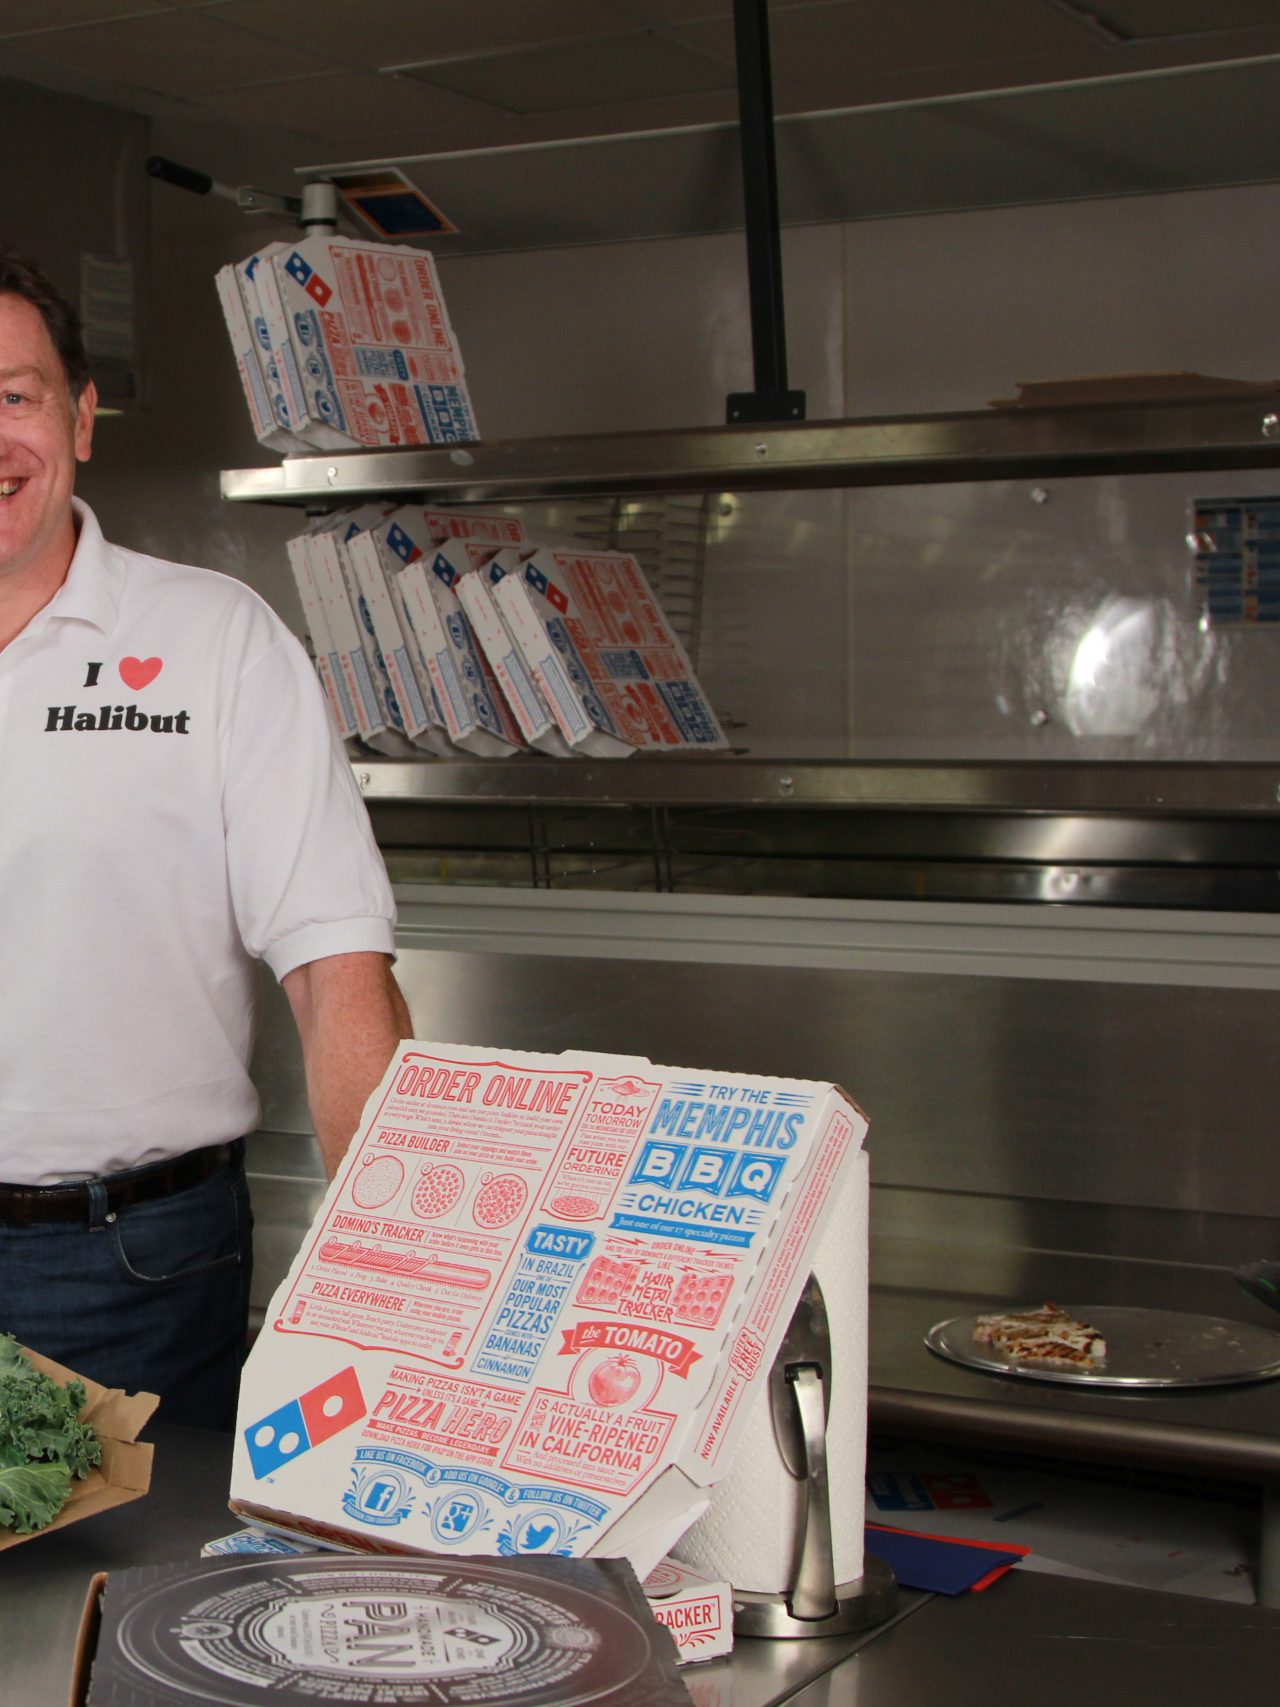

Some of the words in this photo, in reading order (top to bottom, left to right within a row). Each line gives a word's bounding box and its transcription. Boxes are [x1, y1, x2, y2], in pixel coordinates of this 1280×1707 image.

[83, 662, 103, 687] I
[44, 704, 190, 734] Halibut
[397, 1065, 482, 1103] ORDER
[482, 1075, 579, 1114] ONLINE
[709, 1084, 739, 1102] TRY
[740, 1087, 772, 1104] THE
[586, 1113, 642, 1128] TOMORROW
[592, 1101, 647, 1117] TODAY
[649, 1098, 805, 1150] MEMPHIS
[378, 1131, 407, 1147] PIZZA
[407, 1135, 450, 1153] BUILDER
[564, 1162, 620, 1176] ORDERING
[568, 1148, 626, 1167] FUTURE
[641, 1148, 773, 1191] BBQ
[637, 1194, 746, 1224] CHICKEN
[332, 1215, 379, 1235] DOMINO'S
[616, 1217, 633, 1227] Just
[634, 1221, 647, 1229] one
[648, 1221, 658, 1230] of
[674, 1226, 682, 1235] 17
[683, 1225, 719, 1241] specialty
[719, 1233, 745, 1243] pizzas
[533, 1231, 590, 1255] TASTY
[651, 1242, 672, 1251] ORDER
[673, 1244, 696, 1255] ONLINE
[521, 1257, 534, 1270] IN
[536, 1260, 575, 1278] BRAZIL
[657, 1261, 671, 1269] LIKE
[512, 1278, 536, 1294] OUR
[537, 1283, 569, 1299] MOST
[642, 1271, 674, 1290] HAIR
[312, 1282, 340, 1298] PIZZA
[341, 1286, 406, 1312] EVERYWHERE
[505, 1292, 561, 1315] POPULAR
[632, 1285, 672, 1304] METAL
[496, 1307, 554, 1335] PIZZAS
[618, 1298, 674, 1323] TRACKER
[486, 1334, 541, 1358] BANANAS
[581, 1326, 602, 1340] the
[604, 1325, 683, 1359] TOMATO
[731, 1332, 748, 1365] GLUTEN
[737, 1338, 756, 1371] FREE
[477, 1357, 531, 1378] CINNAMON
[745, 1344, 763, 1377] CRUST
[389, 1370, 426, 1386] MAKING
[426, 1377, 459, 1393] PIZZAS
[460, 1384, 483, 1397] ISN'T
[484, 1390, 492, 1399] A
[493, 1391, 522, 1407] GAME.
[422, 1389, 445, 1400] UNLESS
[445, 1393, 456, 1402] IT'S
[372, 1390, 446, 1430] PIZZA
[441, 1404, 512, 1444] HERO
[536, 1398, 549, 1410] IS
[550, 1401, 613, 1423] ACTUALLY
[613, 1414, 623, 1426] A
[625, 1416, 666, 1434] FRUIT
[700, 1433, 715, 1460] NOW
[715, 1378, 739, 1434] AVAILABLE
[376, 1421, 394, 1432] MAKE
[421, 1431, 449, 1445] BECOME
[548, 1415, 659, 1454] VINE-RIPENED
[519, 1431, 540, 1449] IN
[542, 1435, 641, 1472] CALIFORNIA
[360, 1451, 373, 1460] LIKE
[375, 1452, 385, 1462] US
[386, 1454, 395, 1463] ON
[396, 1455, 427, 1472] FACEBOOK
[430, 1469, 438, 1483] &
[444, 1469, 457, 1480] ADD
[458, 1471, 468, 1481] US
[469, 1473, 478, 1483] ON
[478, 1474, 505, 1492] GOOGLE+
[508, 1488, 517, 1501] &
[523, 1490, 550, 1501] FOLLOW
[552, 1493, 561, 1503] US
[563, 1495, 572, 1505] ON
[572, 1497, 601, 1516] TWITTER
[655, 1604, 712, 1629] RACKER
[320, 1620, 338, 1646] PIZZA
[342, 1600, 417, 1669] PAN
[416, 1612, 435, 1657] HANDMADE
